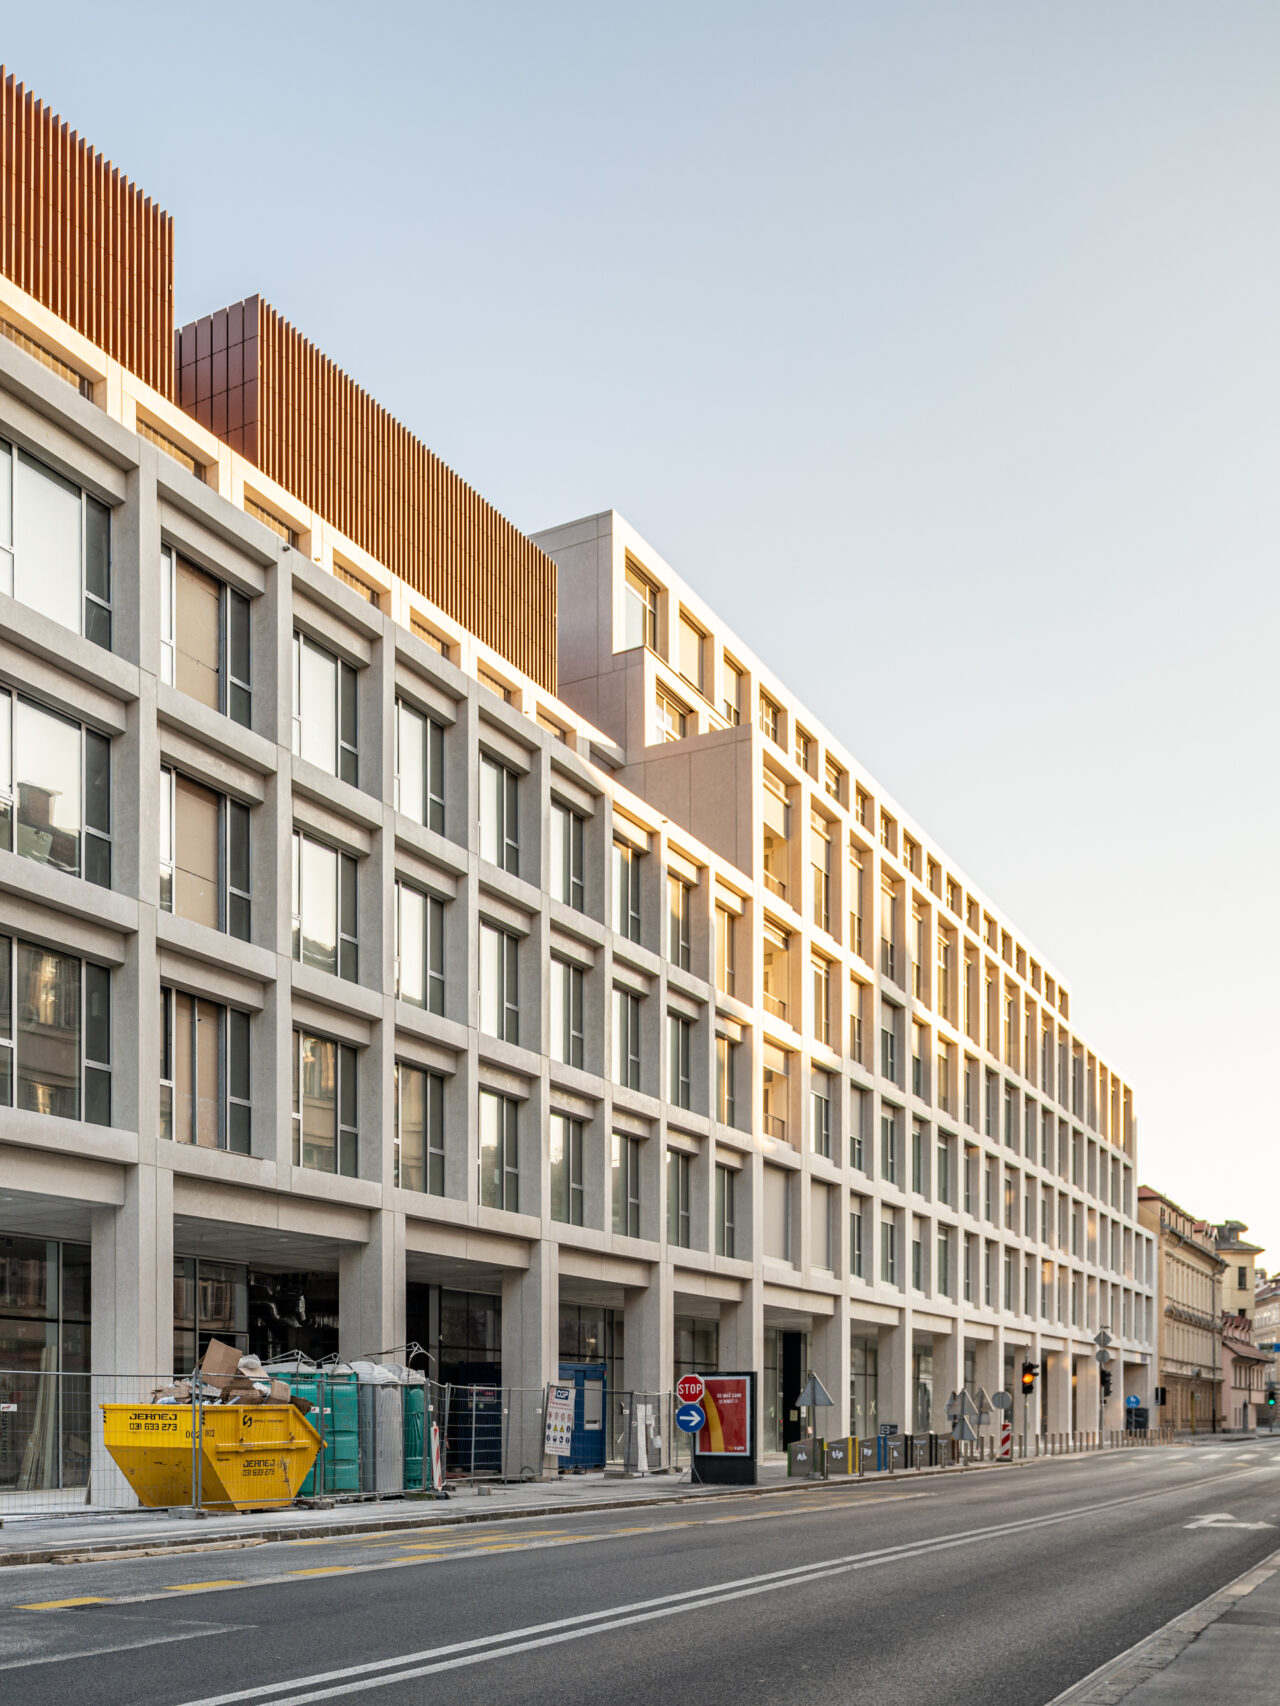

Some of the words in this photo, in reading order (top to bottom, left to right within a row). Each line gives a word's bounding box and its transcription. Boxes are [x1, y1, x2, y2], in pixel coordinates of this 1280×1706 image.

[678, 1383, 702, 1395] STOP
[556, 1390, 569, 1399] CGP
[129, 1413, 178, 1421] JERNEJ
[129, 1422, 142, 1431] 031
[144, 1422, 160, 1431] 633
[161, 1423, 178, 1431] 273
[0, 1400, 8, 1463] CONTAIN
[242, 1459, 276, 1468] JERNEJ
[242, 1469, 252, 1477] 031
[253, 1469, 264, 1477] 633
[264, 1468, 275, 1476] 273
